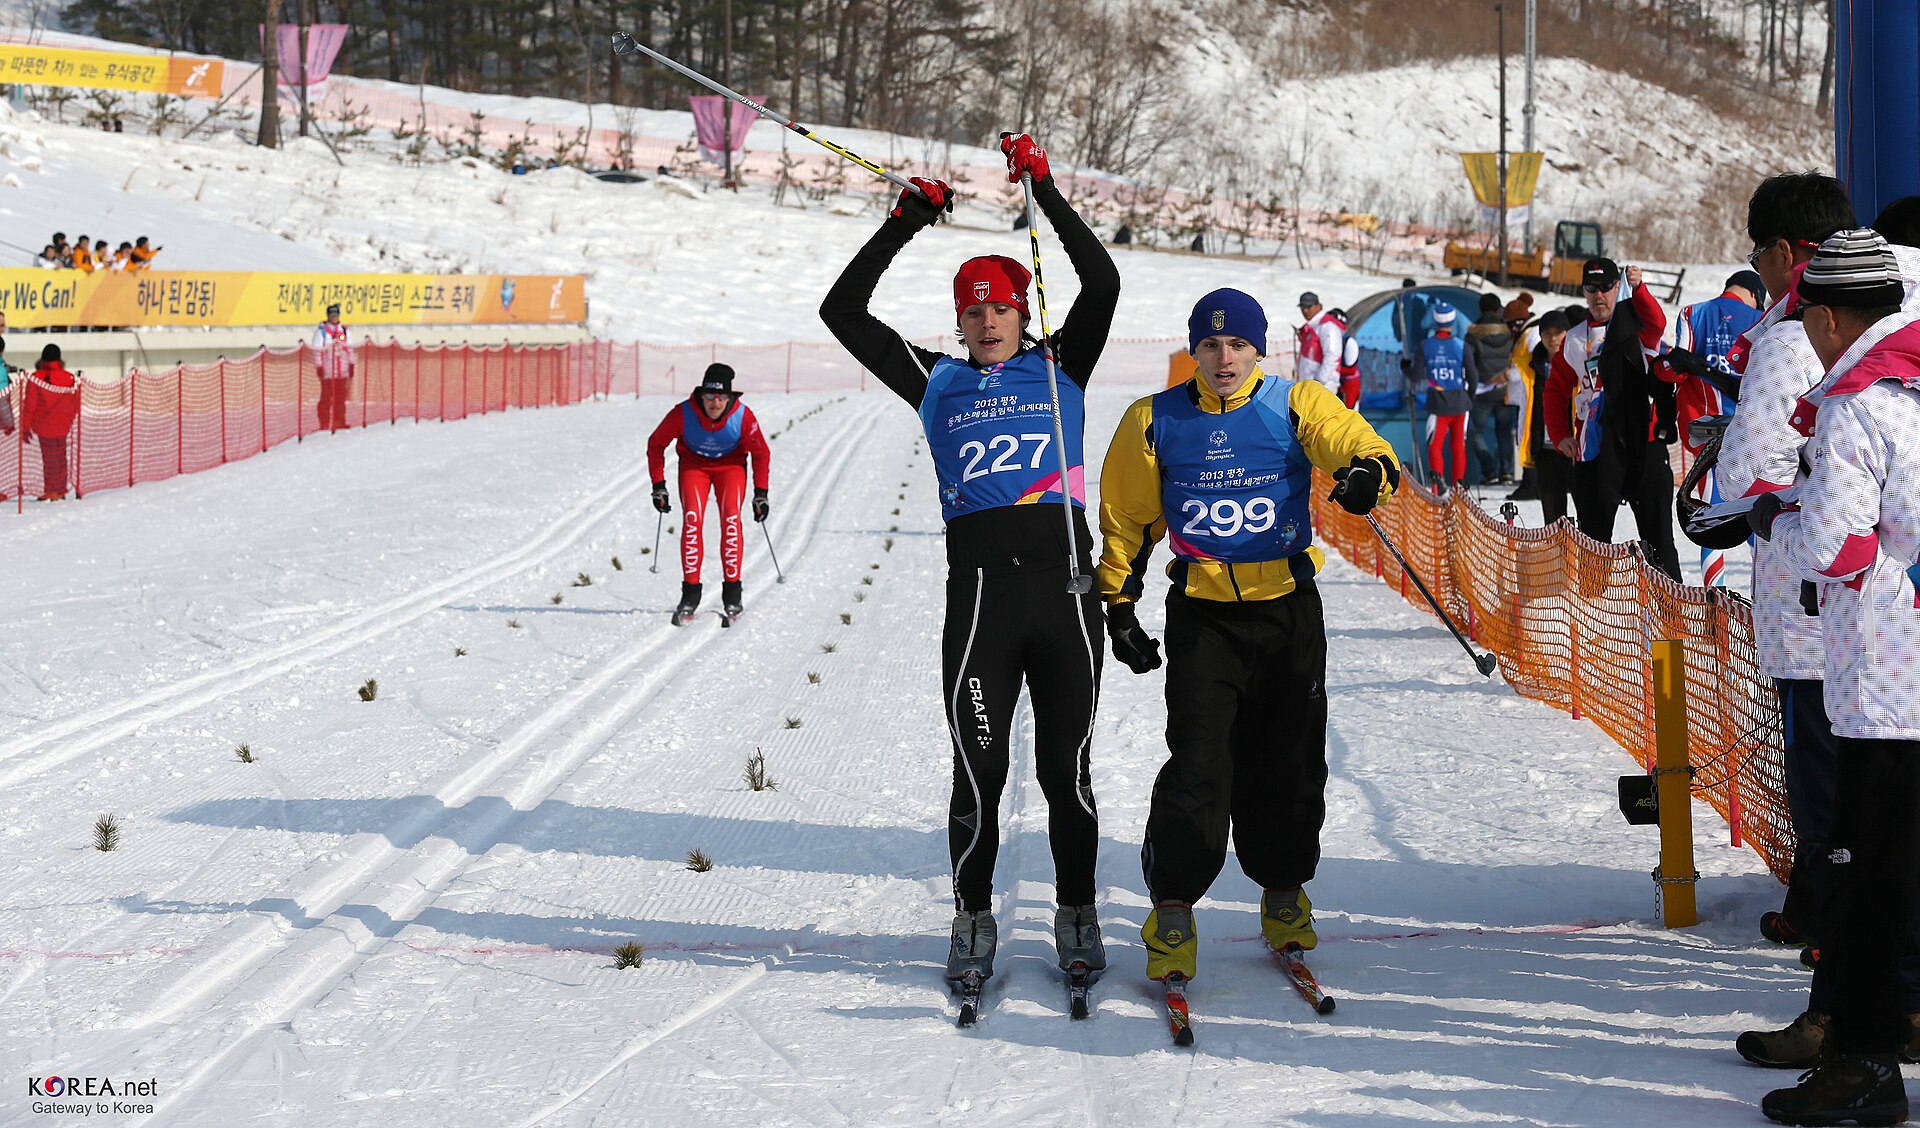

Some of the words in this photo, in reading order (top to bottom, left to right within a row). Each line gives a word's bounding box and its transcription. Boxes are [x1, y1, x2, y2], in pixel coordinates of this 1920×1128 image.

[10, 56, 48, 75] 따뜻한
[105, 63, 155, 83] 휴식공간
[15, 281, 37, 310] We
[42, 280, 77, 309] Can!
[185, 280, 216, 318] 감동!
[277, 283, 314, 313] 전세계
[408, 284, 445, 309] 스포츠
[451, 284, 475, 313] 축제
[1431, 367, 1455, 381] 151
[947, 413, 962, 428] 동계
[963, 406, 1016, 421] 스페셜올림픽
[1017, 402, 1053, 412] 세계대회
[974, 398, 998, 409] 2013
[1000, 395, 1018, 406] 평창
[958, 433, 1051, 484] 227
[1207, 447, 1231, 455] Special
[1199, 470, 1224, 481] 2013
[1226, 467, 1246, 479] 평창
[1181, 496, 1276, 537] 299
[685, 510, 699, 575] CANADA
[725, 513, 738, 579] CANADA
[968, 677, 990, 734] CRAFT
